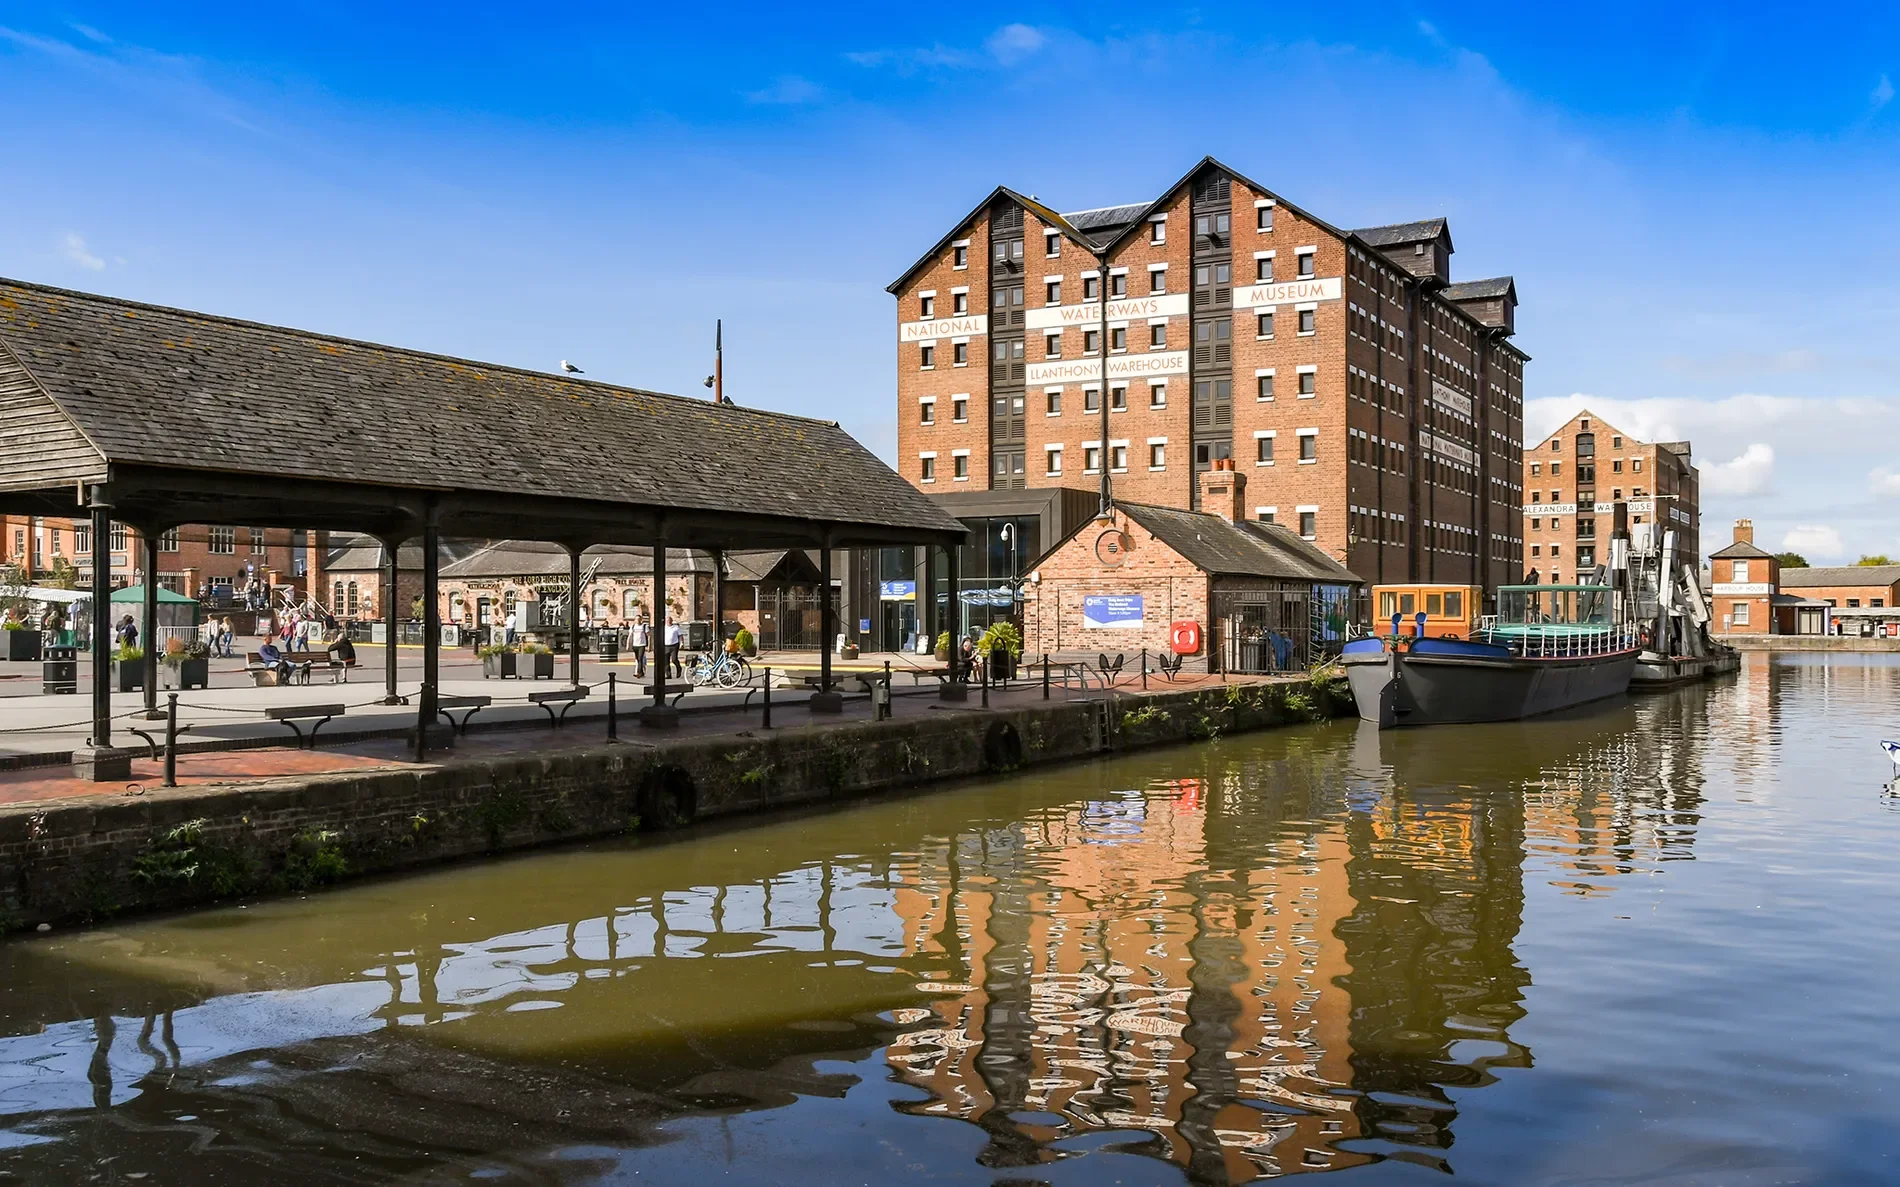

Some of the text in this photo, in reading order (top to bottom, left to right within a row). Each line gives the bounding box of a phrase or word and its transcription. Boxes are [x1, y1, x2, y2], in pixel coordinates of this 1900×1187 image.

[908, 284, 1325, 337] NATIONAL WATERWAYS MUSEUM
[1030, 357, 1183, 380] LLANTHONY WAREHOUSE
[1523, 502, 1652, 514] ALEXANDRA WAROUSE
